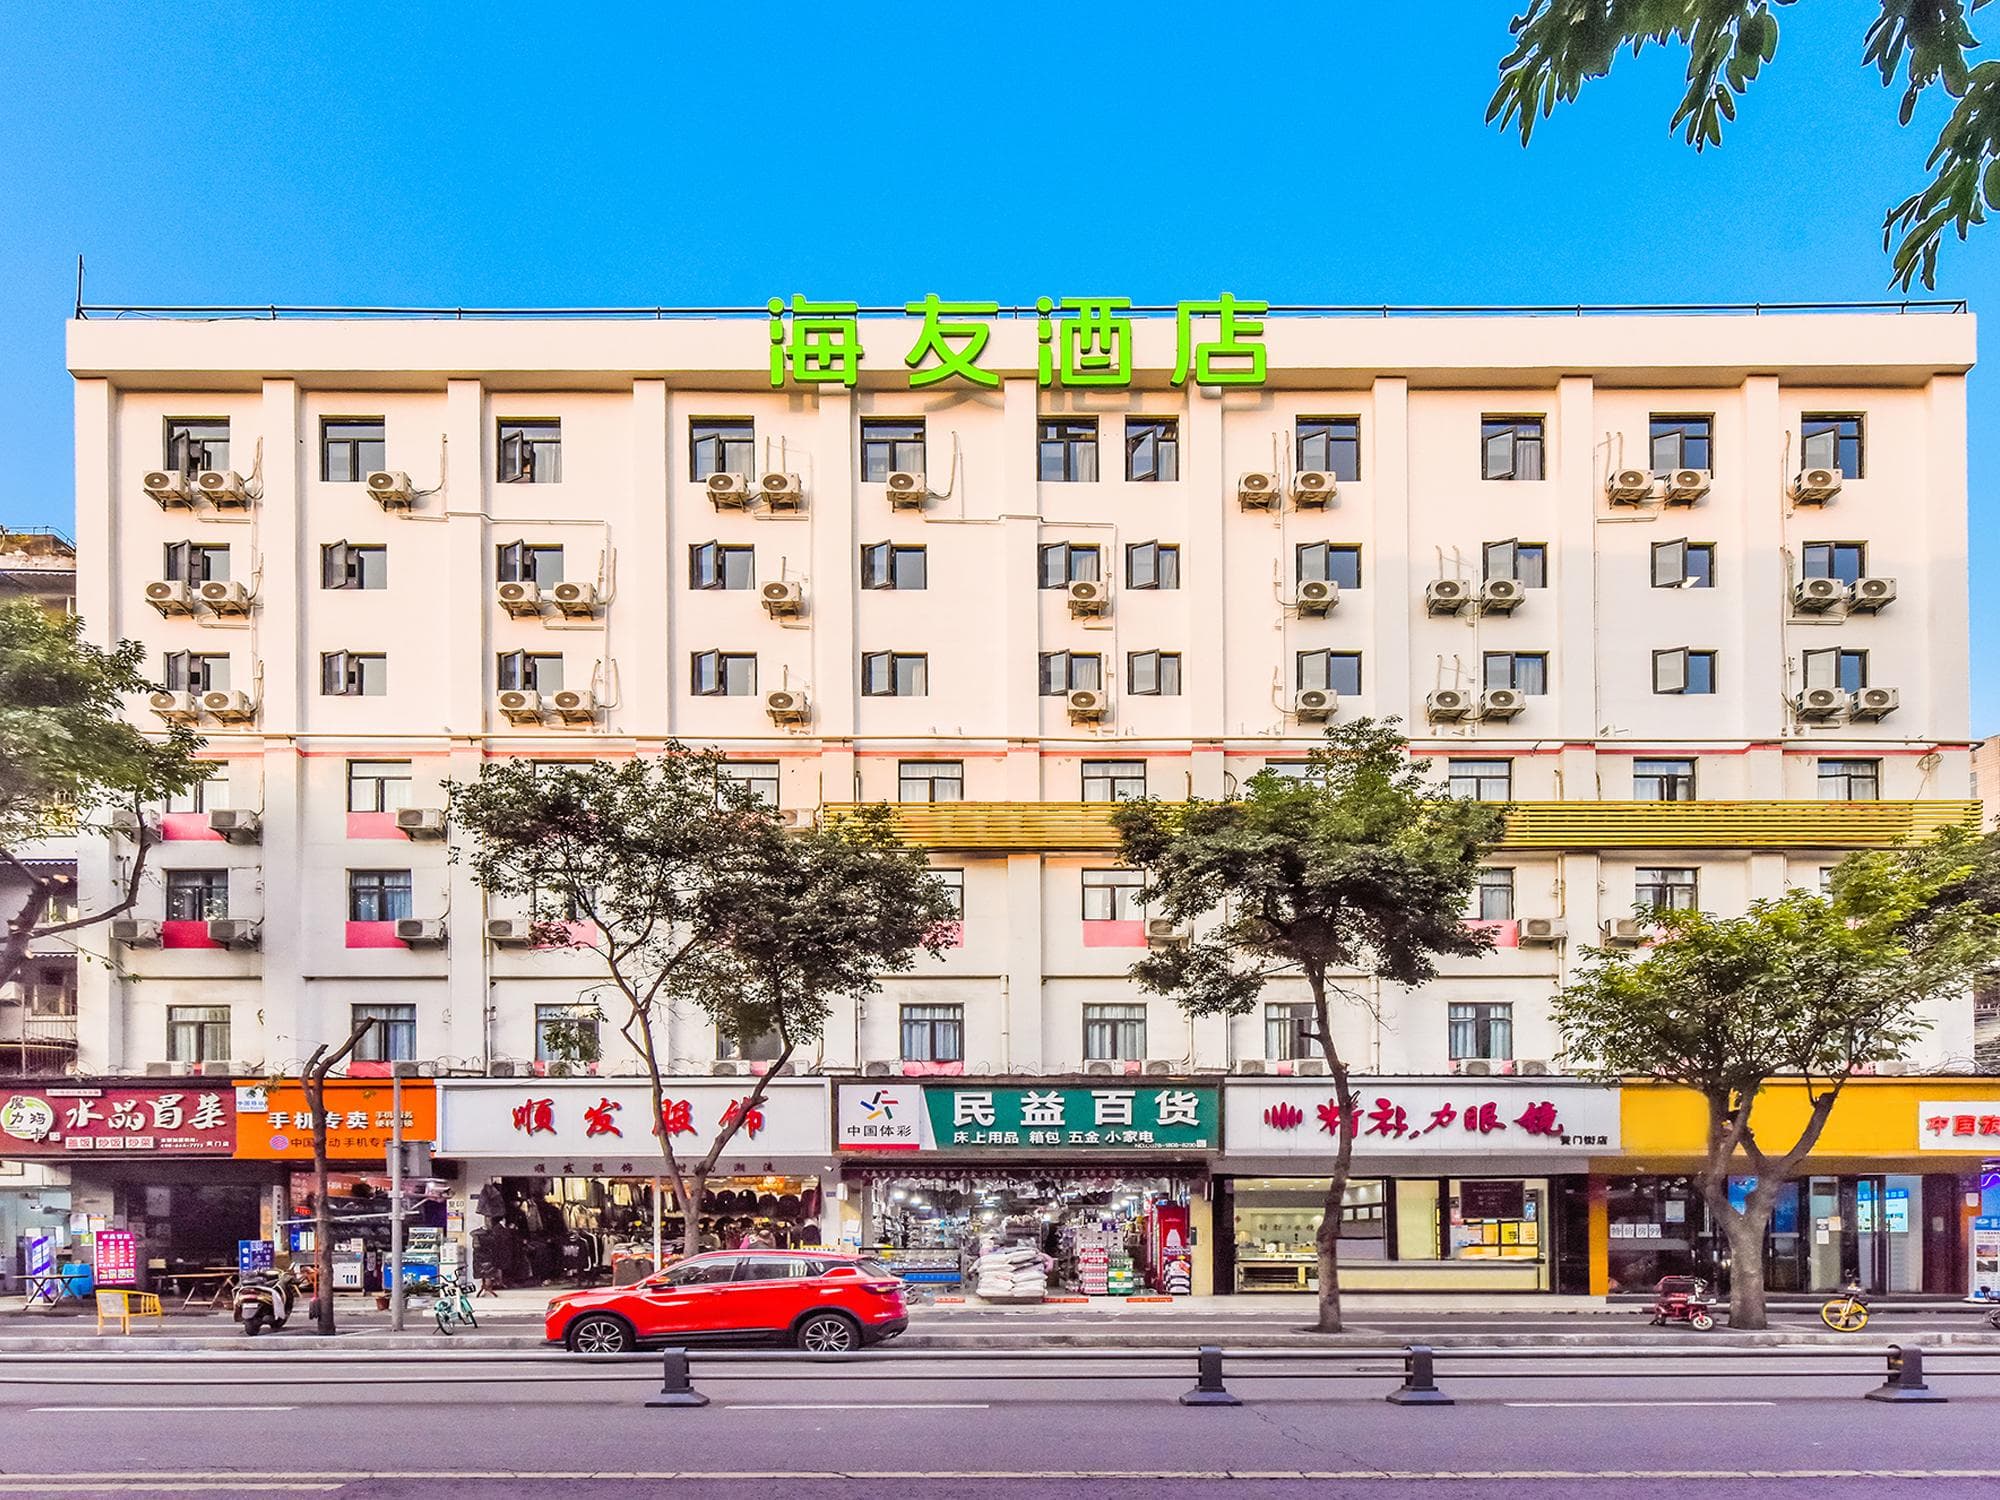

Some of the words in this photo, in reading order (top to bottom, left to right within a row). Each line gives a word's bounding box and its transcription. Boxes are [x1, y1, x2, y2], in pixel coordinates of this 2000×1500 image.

[767, 292, 1268, 389] 海友酒店
[66, 1092, 227, 1131] 水晶冒菜
[267, 1111, 369, 1129] 手机专卖
[512, 1096, 765, 1139] 顺发服饰
[953, 1090, 1200, 1127] 民益百货
[847, 1125, 912, 1137] 中国体彩
[954, 1131, 1019, 1144] 床上用品
[1029, 1131, 1061, 1144] 箱包
[1068, 1131, 1099, 1144] 五金
[1105, 1131, 1154, 1143] 小家电
